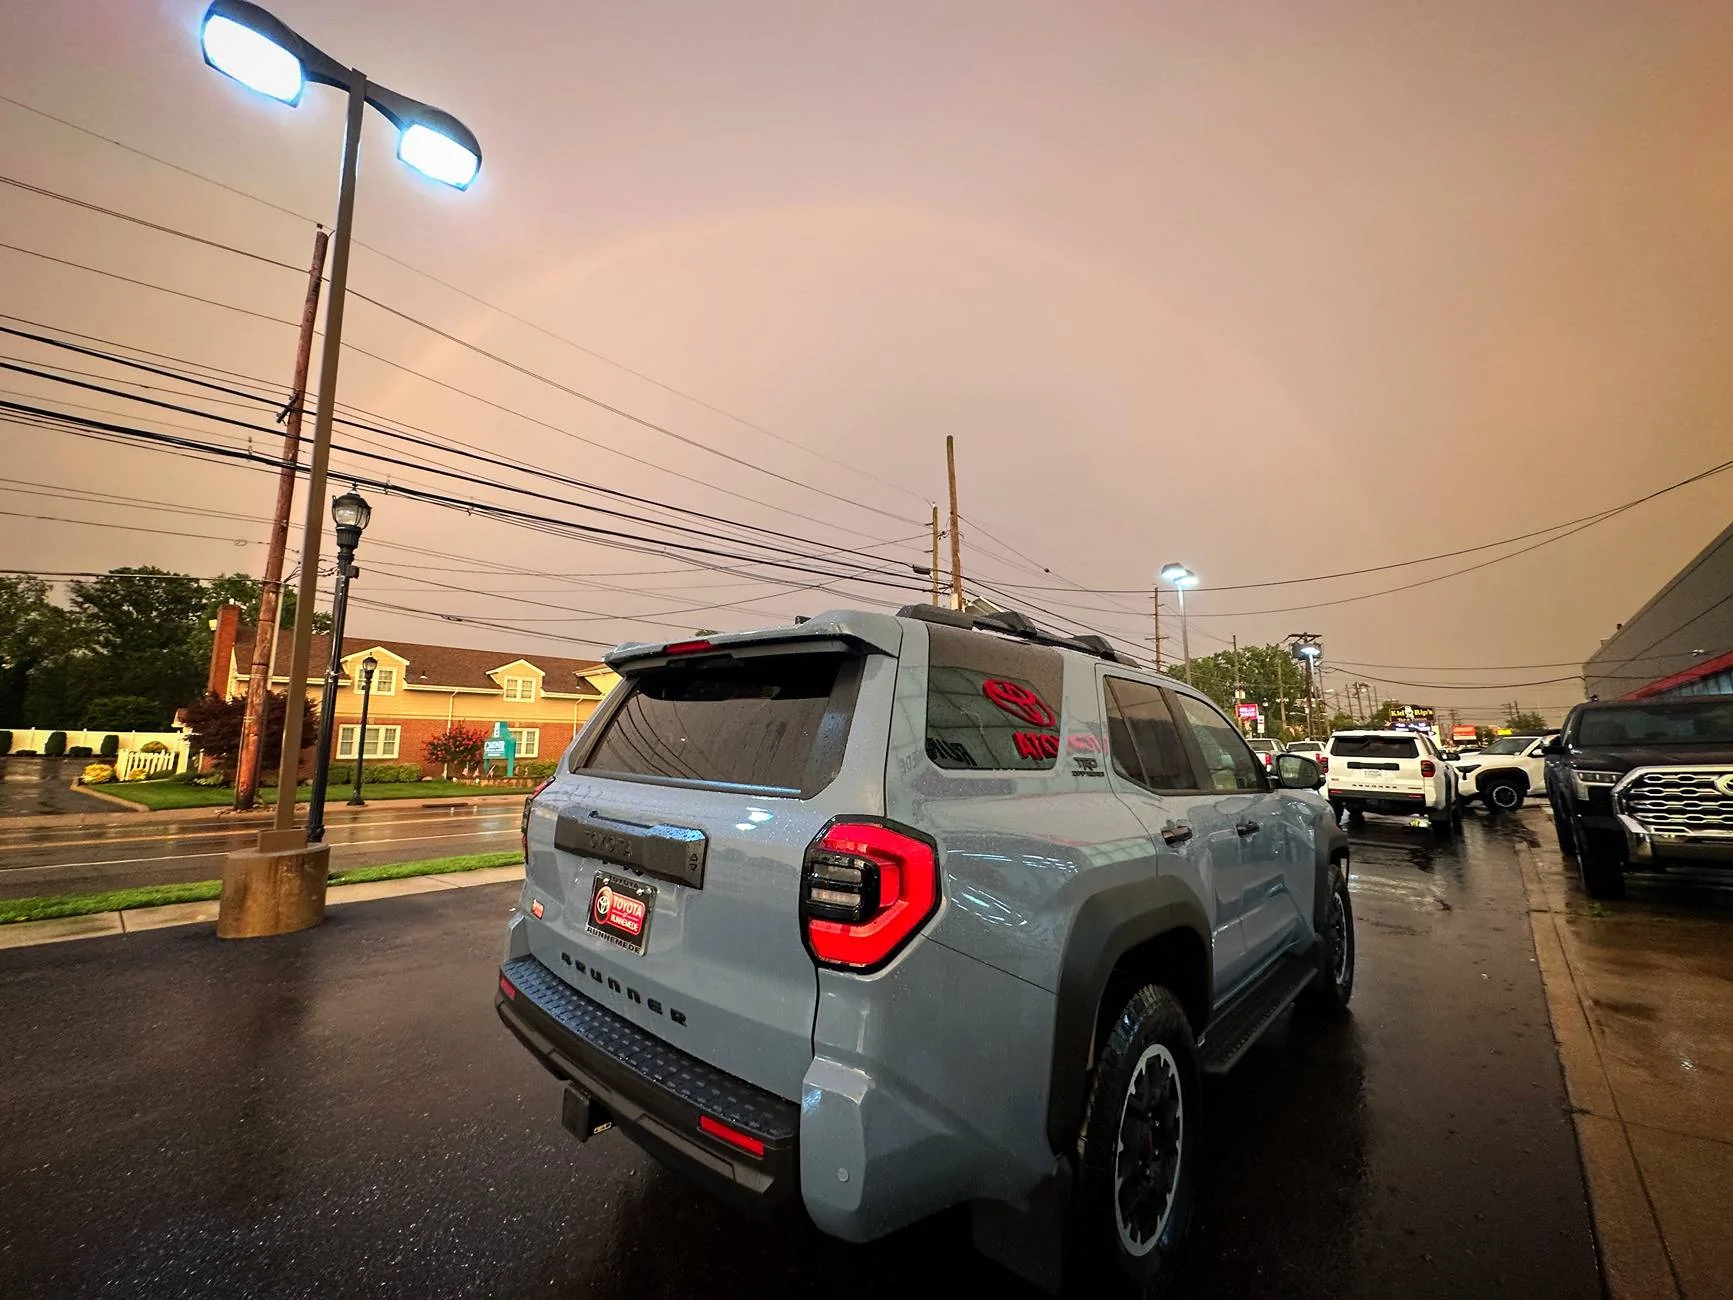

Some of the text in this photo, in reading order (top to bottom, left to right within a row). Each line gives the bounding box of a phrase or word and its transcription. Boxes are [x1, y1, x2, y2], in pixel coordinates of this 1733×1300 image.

[1073, 757, 1098, 771] TRD
[613, 896, 642, 916] TOYOTA
[610, 914, 639, 931] RUNNEMEDE
[587, 927, 641, 954] RUNNEMEDE
